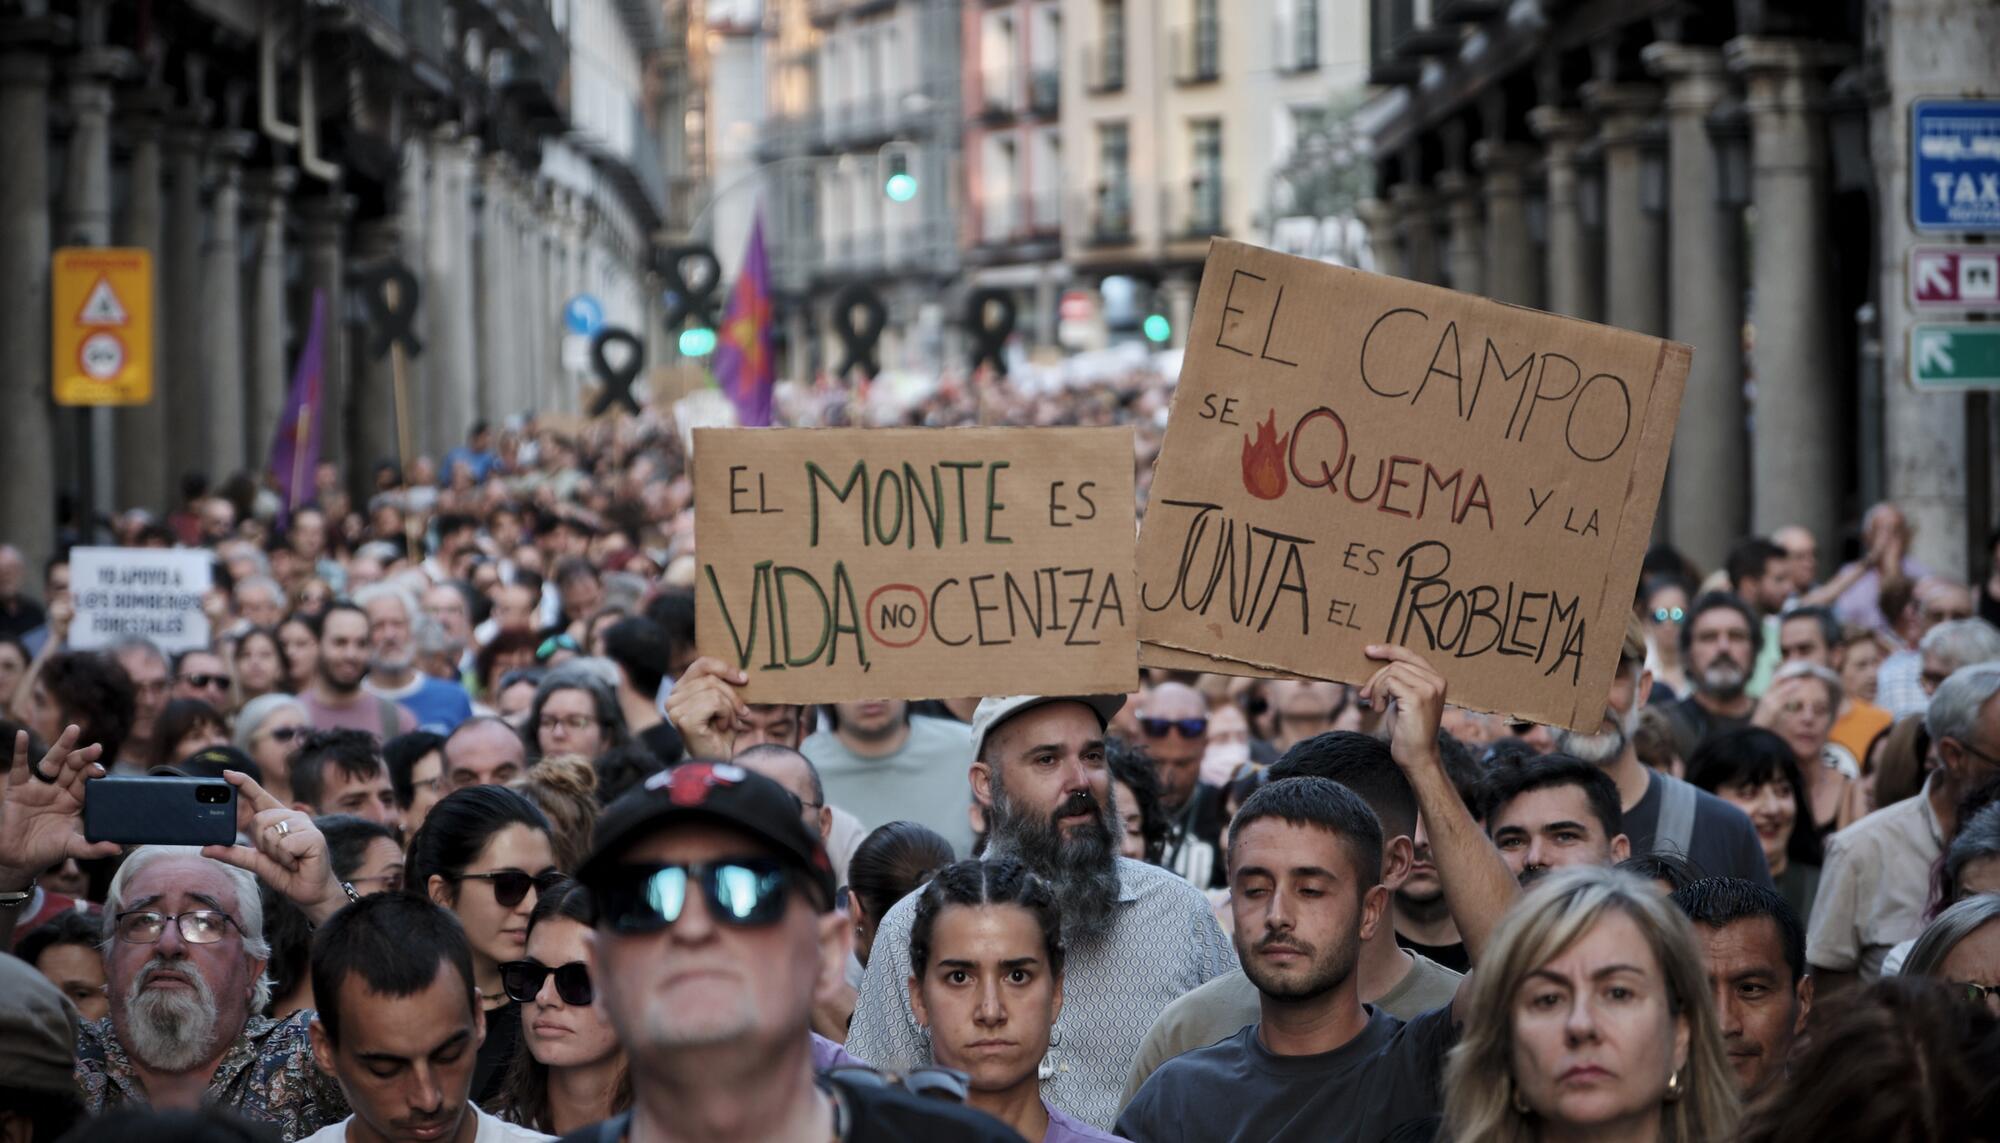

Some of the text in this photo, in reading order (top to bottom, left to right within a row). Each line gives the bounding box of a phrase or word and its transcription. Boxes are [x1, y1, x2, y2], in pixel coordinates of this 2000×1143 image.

[1215, 269, 1632, 462] EL CAMPO
[729, 458, 1097, 550] EL MONTE ES
[1198, 393, 1600, 537] SE QUEMA Y LA
[704, 559, 1125, 673] VIDA, NO CENIZA
[1141, 498, 1587, 687] JUNTA ES EL PROBLEMA
